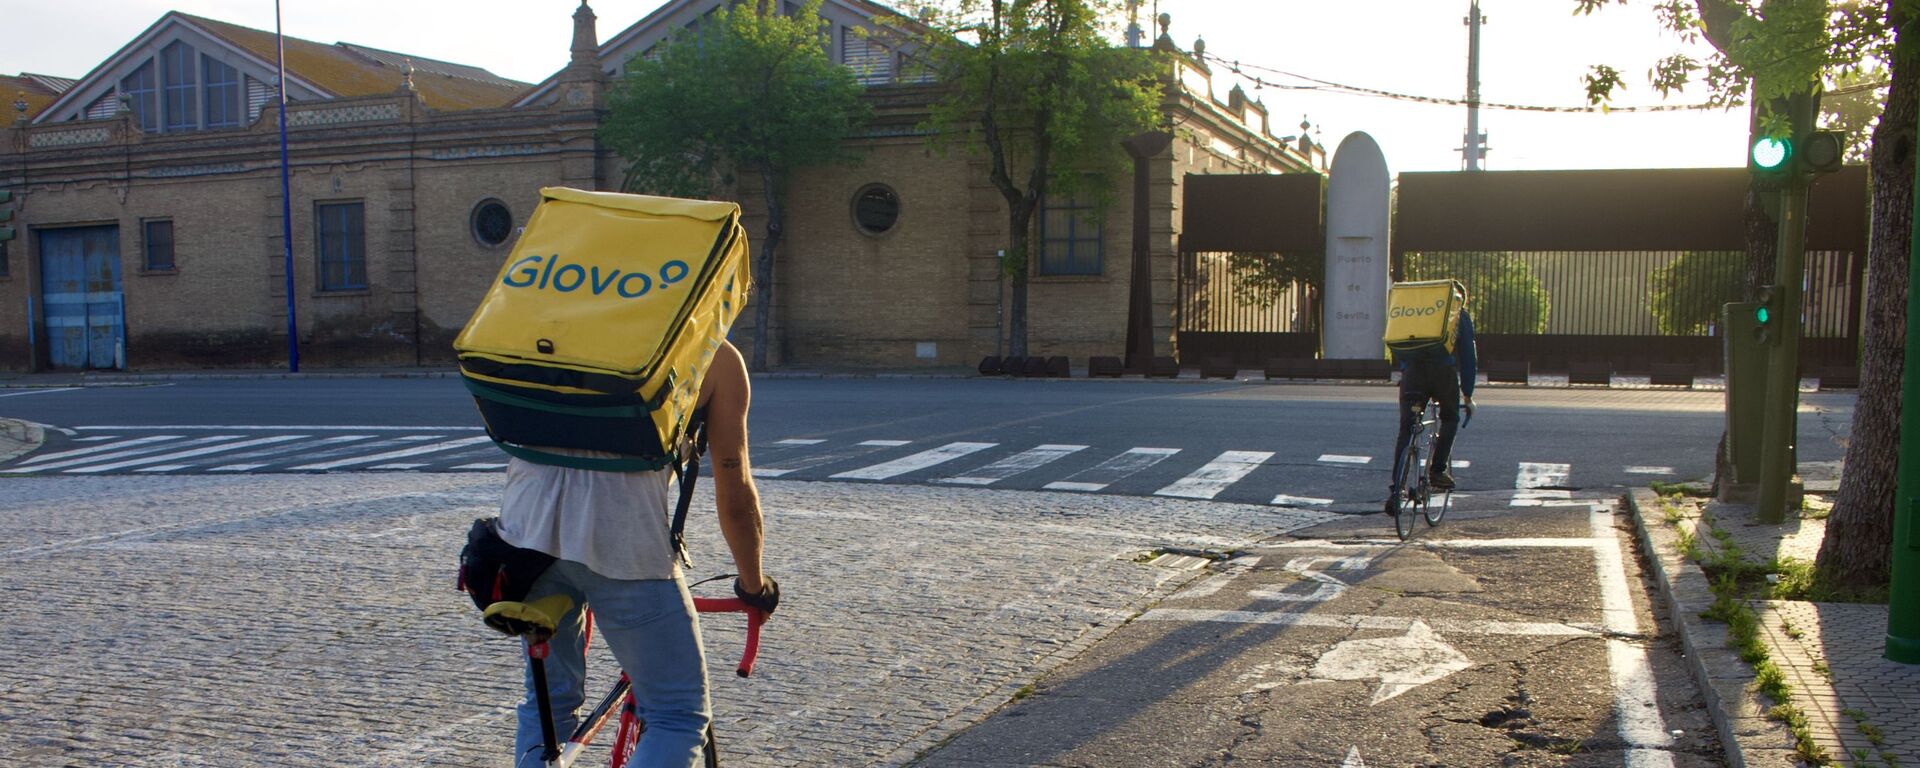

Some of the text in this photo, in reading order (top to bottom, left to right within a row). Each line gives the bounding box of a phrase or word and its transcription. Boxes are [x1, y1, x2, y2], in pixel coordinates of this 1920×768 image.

[1337, 255, 1372, 264] Puerto
[503, 254, 652, 298] Glovo
[1347, 283, 1360, 292] de
[1336, 311, 1370, 320] Sevilla
[1390, 306, 1435, 319] Glovo
